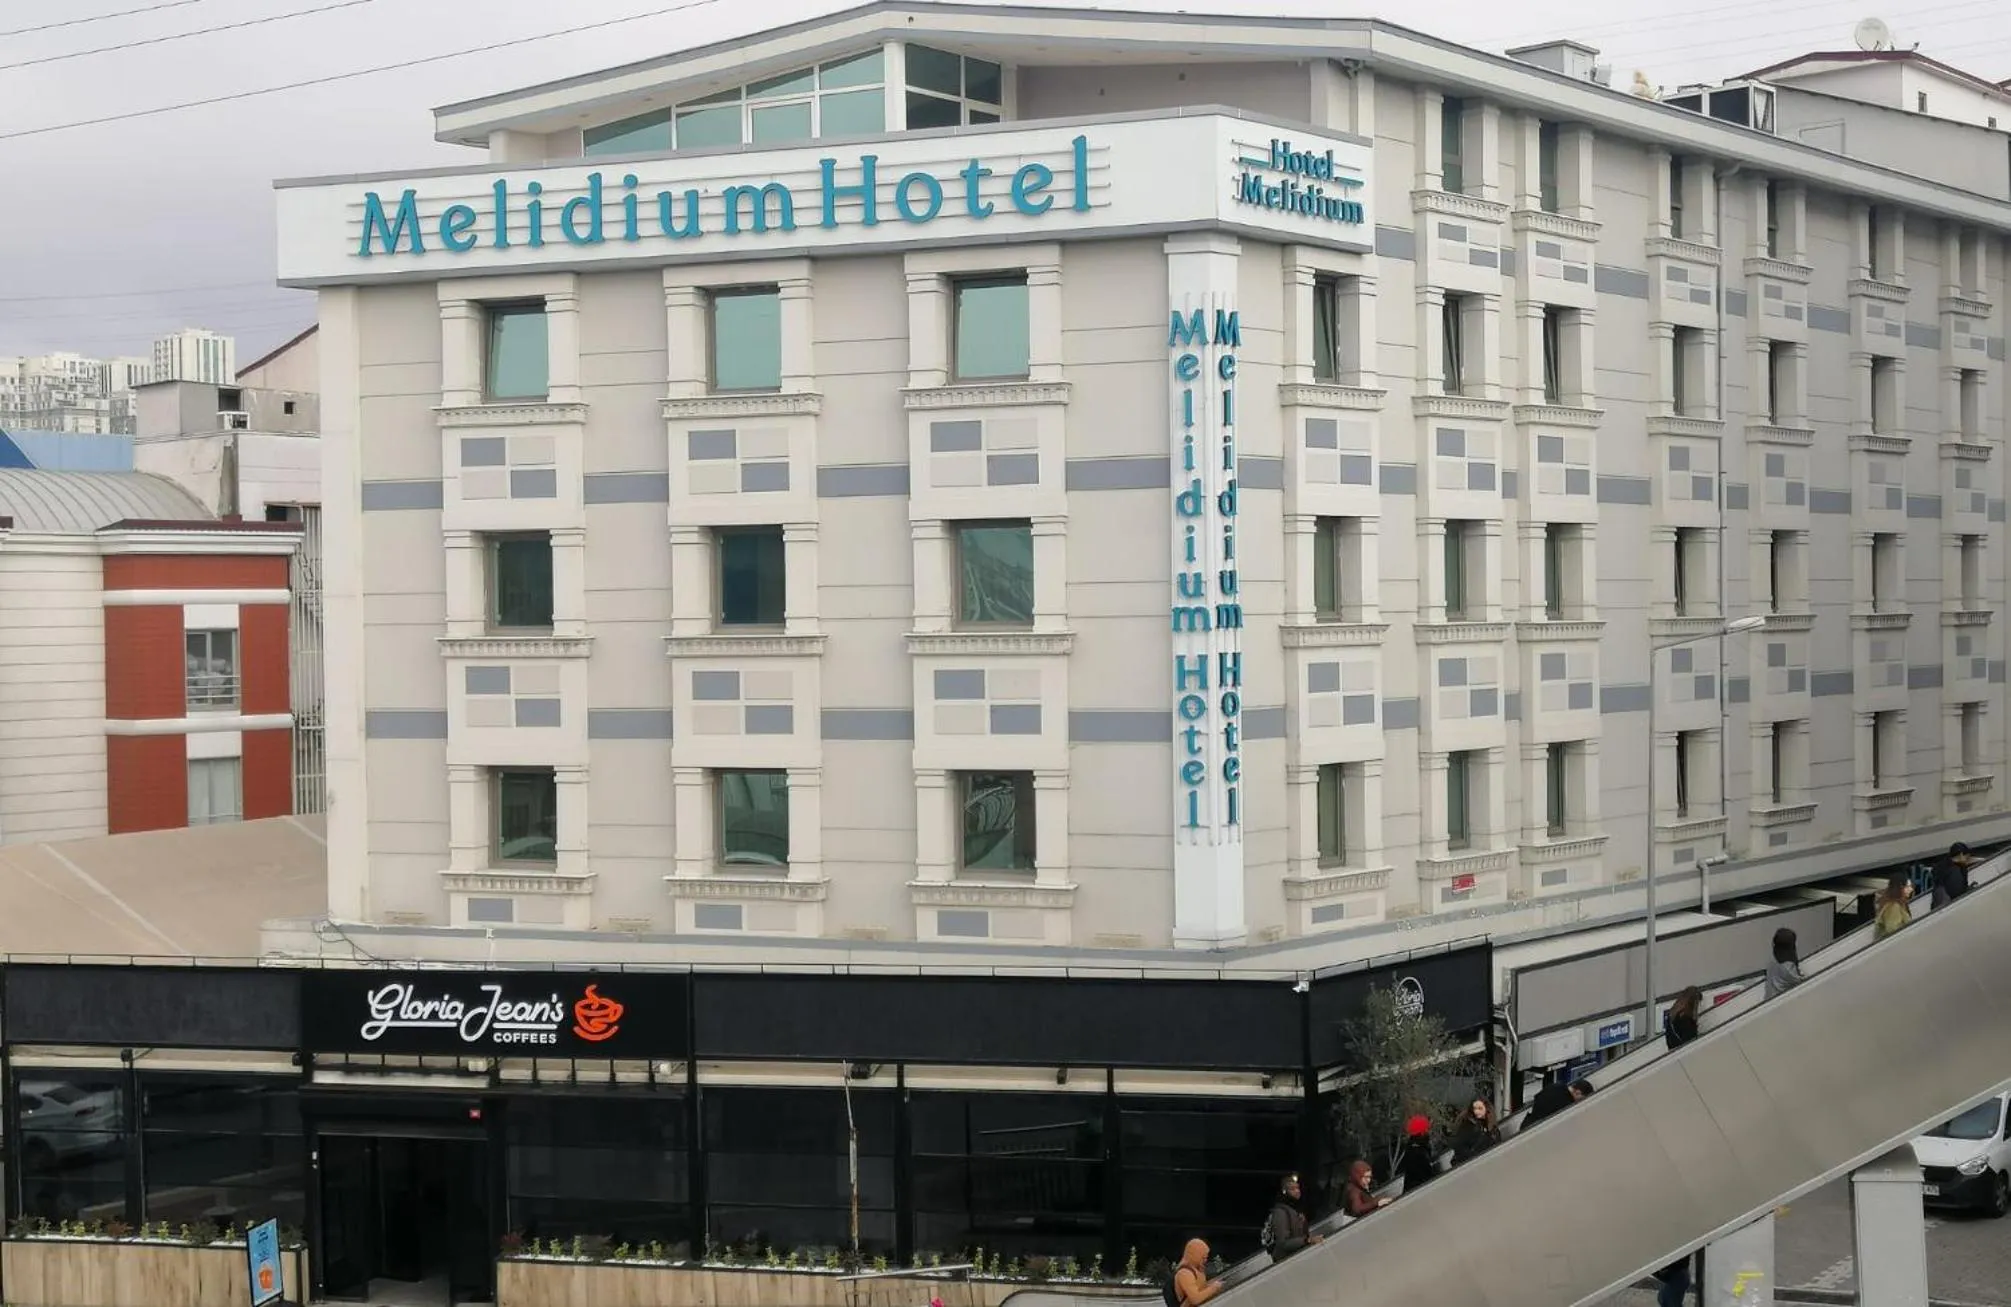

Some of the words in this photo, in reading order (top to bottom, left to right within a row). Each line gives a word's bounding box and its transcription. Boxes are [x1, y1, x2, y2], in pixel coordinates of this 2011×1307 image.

[1271, 139, 1334, 181] Hotel
[1241, 172, 1364, 224] Melidium
[361, 984, 464, 1040] Gloria
[460, 984, 564, 1041] Jean's
[493, 1032, 557, 1044] COFFEES
